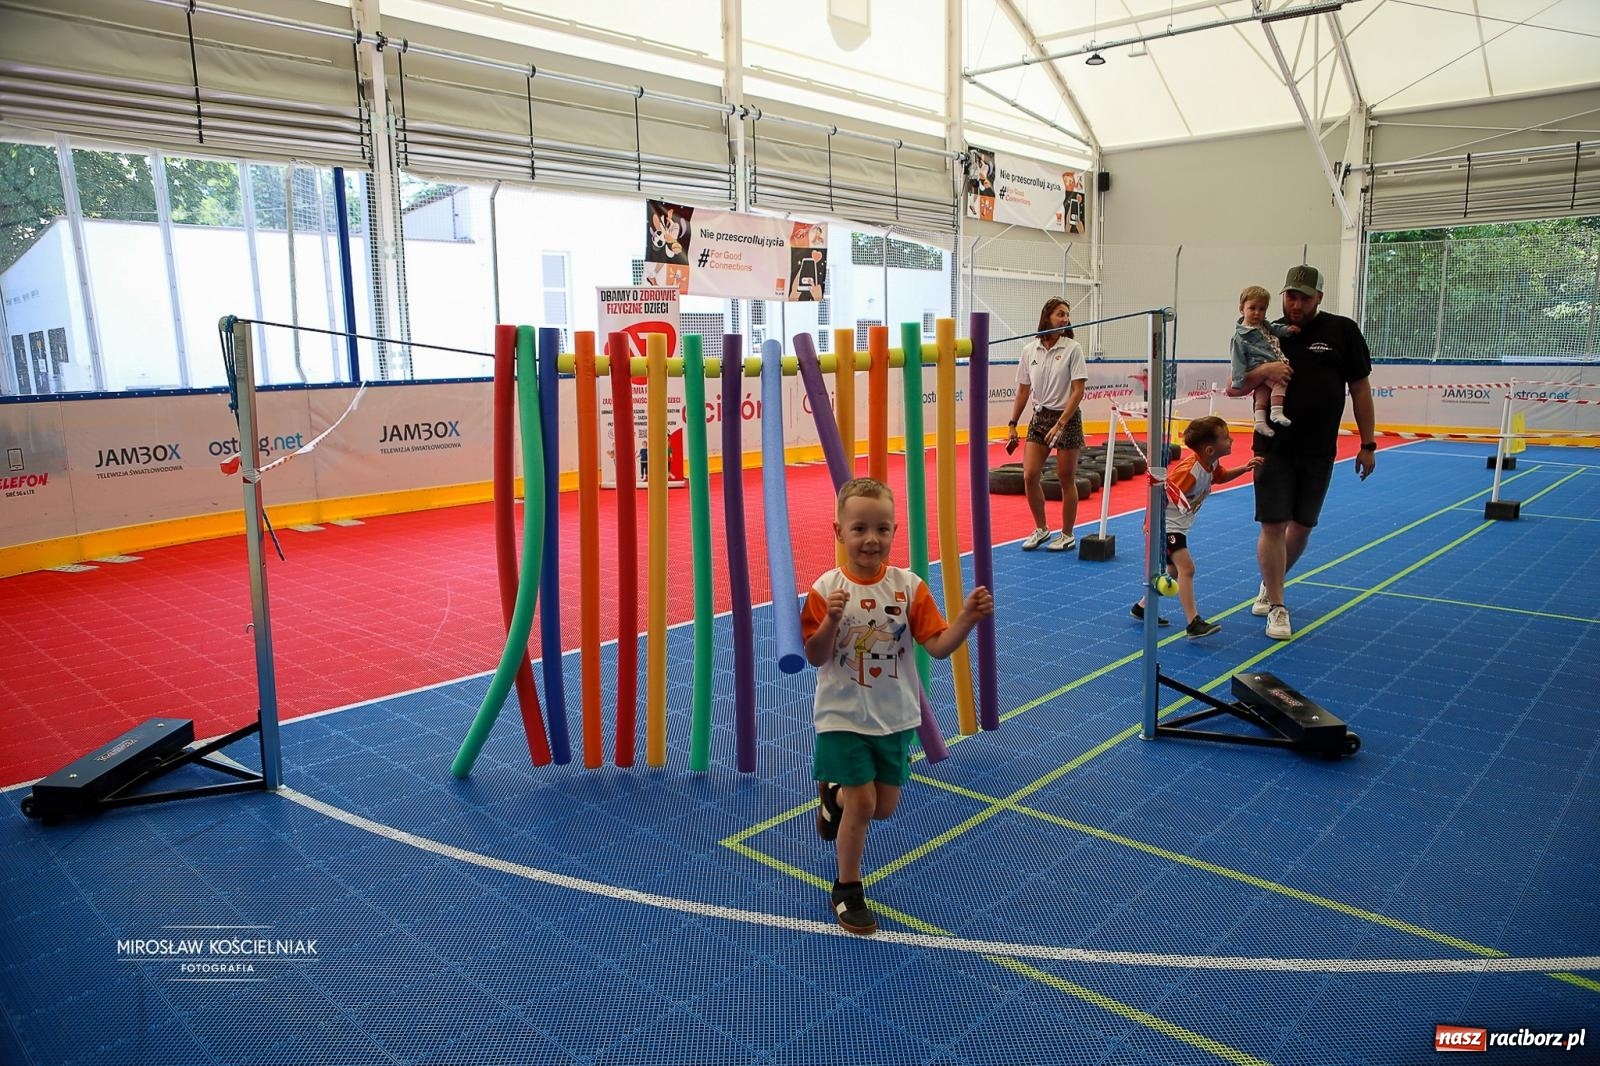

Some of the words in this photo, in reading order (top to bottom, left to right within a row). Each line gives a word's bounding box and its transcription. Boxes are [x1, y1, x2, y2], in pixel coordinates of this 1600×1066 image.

[1000, 169, 1010, 180] Nie
[1011, 174, 1046, 190] przescrolluj
[700, 228, 715, 239] Nie
[716, 232, 765, 248] przescrolluj
[723, 250, 742, 260] Good
[709, 260, 753, 272] Connections
[601, 290, 631, 302] DBAMY
[632, 290, 638, 302] O
[639, 289, 676, 302] ZDROWIE
[607, 302, 642, 314] FIZYCZNE
[644, 302, 669, 314] DZIECI
[1441, 388, 1491, 400] JAMBOX
[379, 421, 461, 443] JAMBOX
[380, 445, 411, 454] TELEWIZJA
[411, 442, 461, 452] ŚWIATŁOWODOWA
[95, 444, 182, 468] JAMBOX
[96, 470, 130, 480] TELEWIZJA
[129, 465, 183, 476] ŚWIATŁOWODOWA
